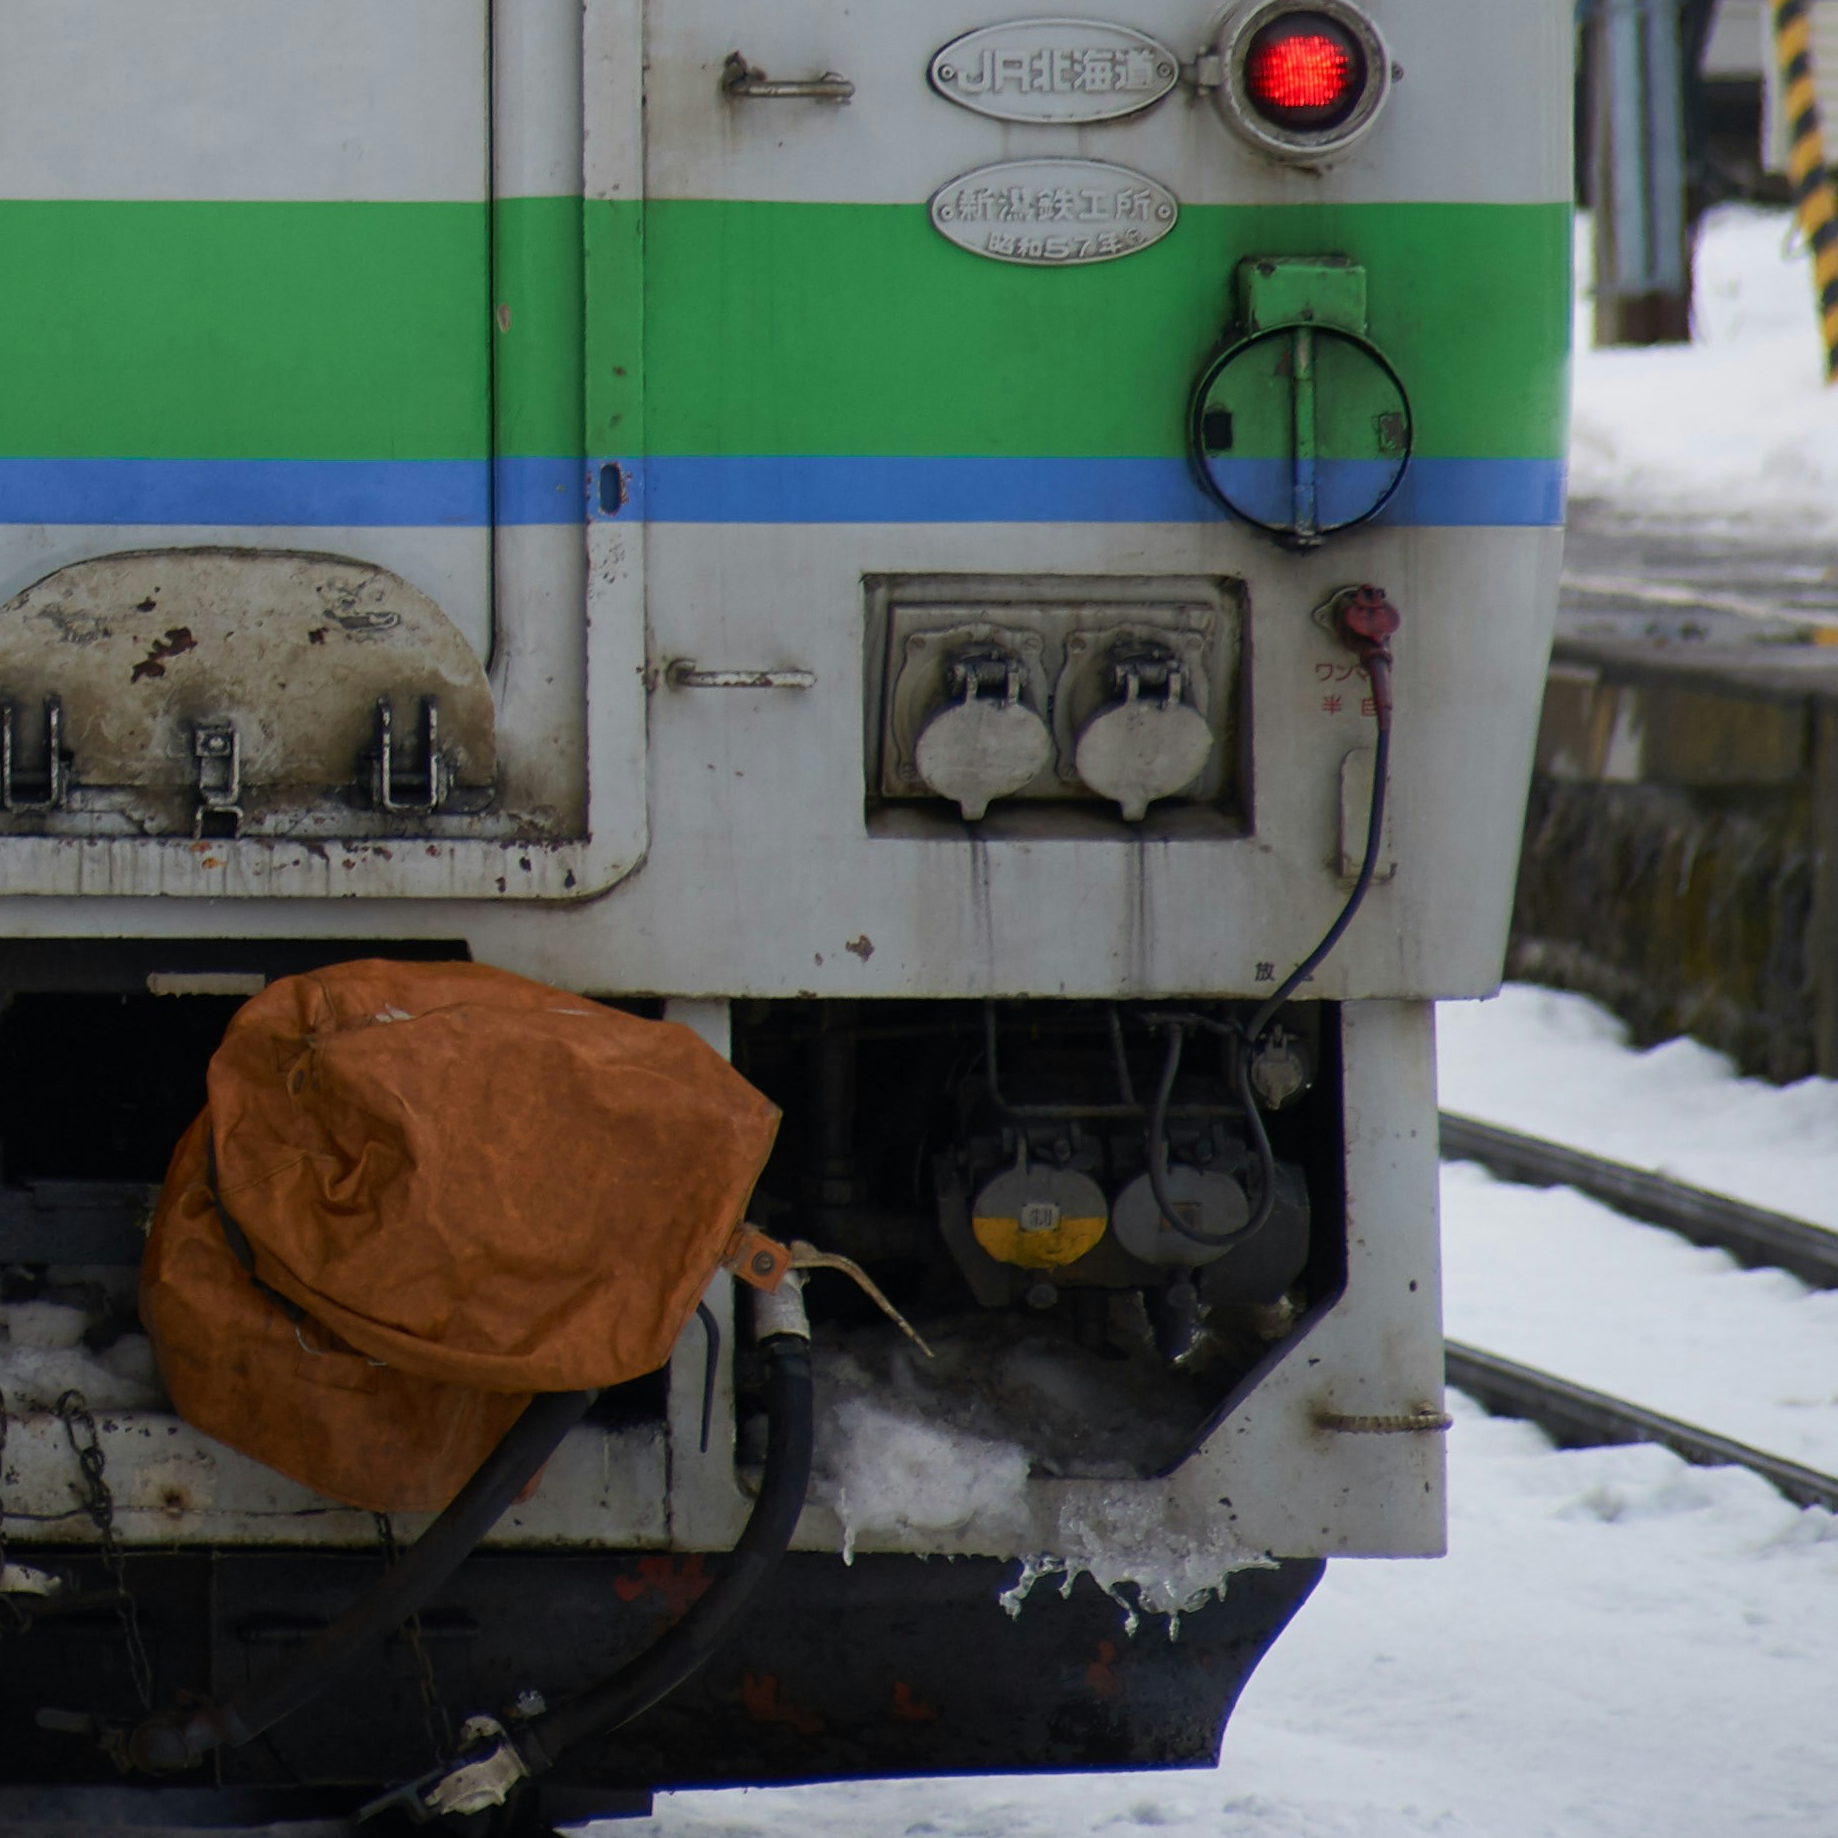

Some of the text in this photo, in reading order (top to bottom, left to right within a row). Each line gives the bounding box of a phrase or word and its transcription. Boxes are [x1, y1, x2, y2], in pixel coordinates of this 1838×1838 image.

[956, 48, 1155, 93] JR北海道
[957, 188, 1152, 222] 新潟鉄工所
